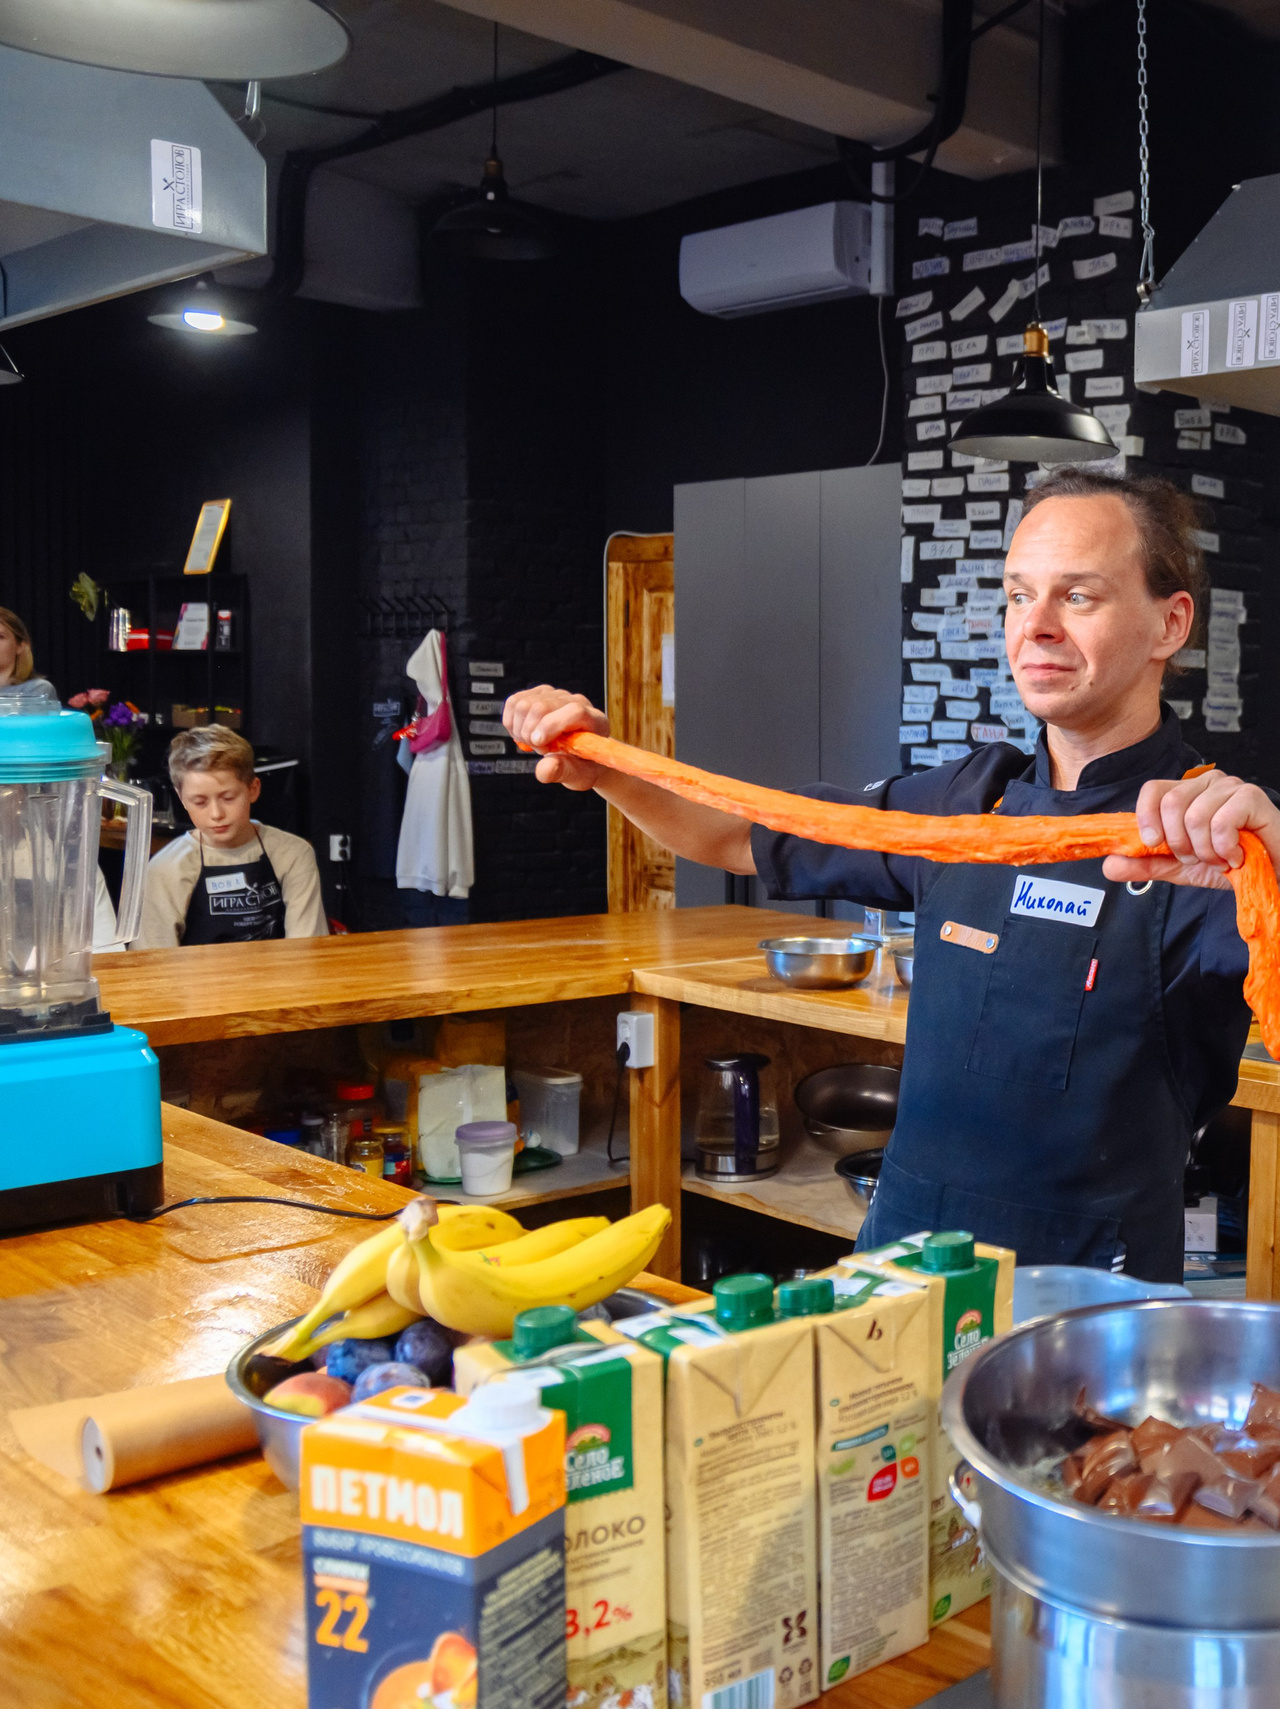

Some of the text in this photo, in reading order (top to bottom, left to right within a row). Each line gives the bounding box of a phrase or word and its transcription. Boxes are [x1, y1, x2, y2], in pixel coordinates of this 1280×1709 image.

[174, 149, 186, 225] ИГРА СТОЛОВ
[972, 726, 1004, 742] ТАНЯ
[310, 1464, 464, 1540] ПЕТМОЛ
[315, 1589, 370, 1654] 22
